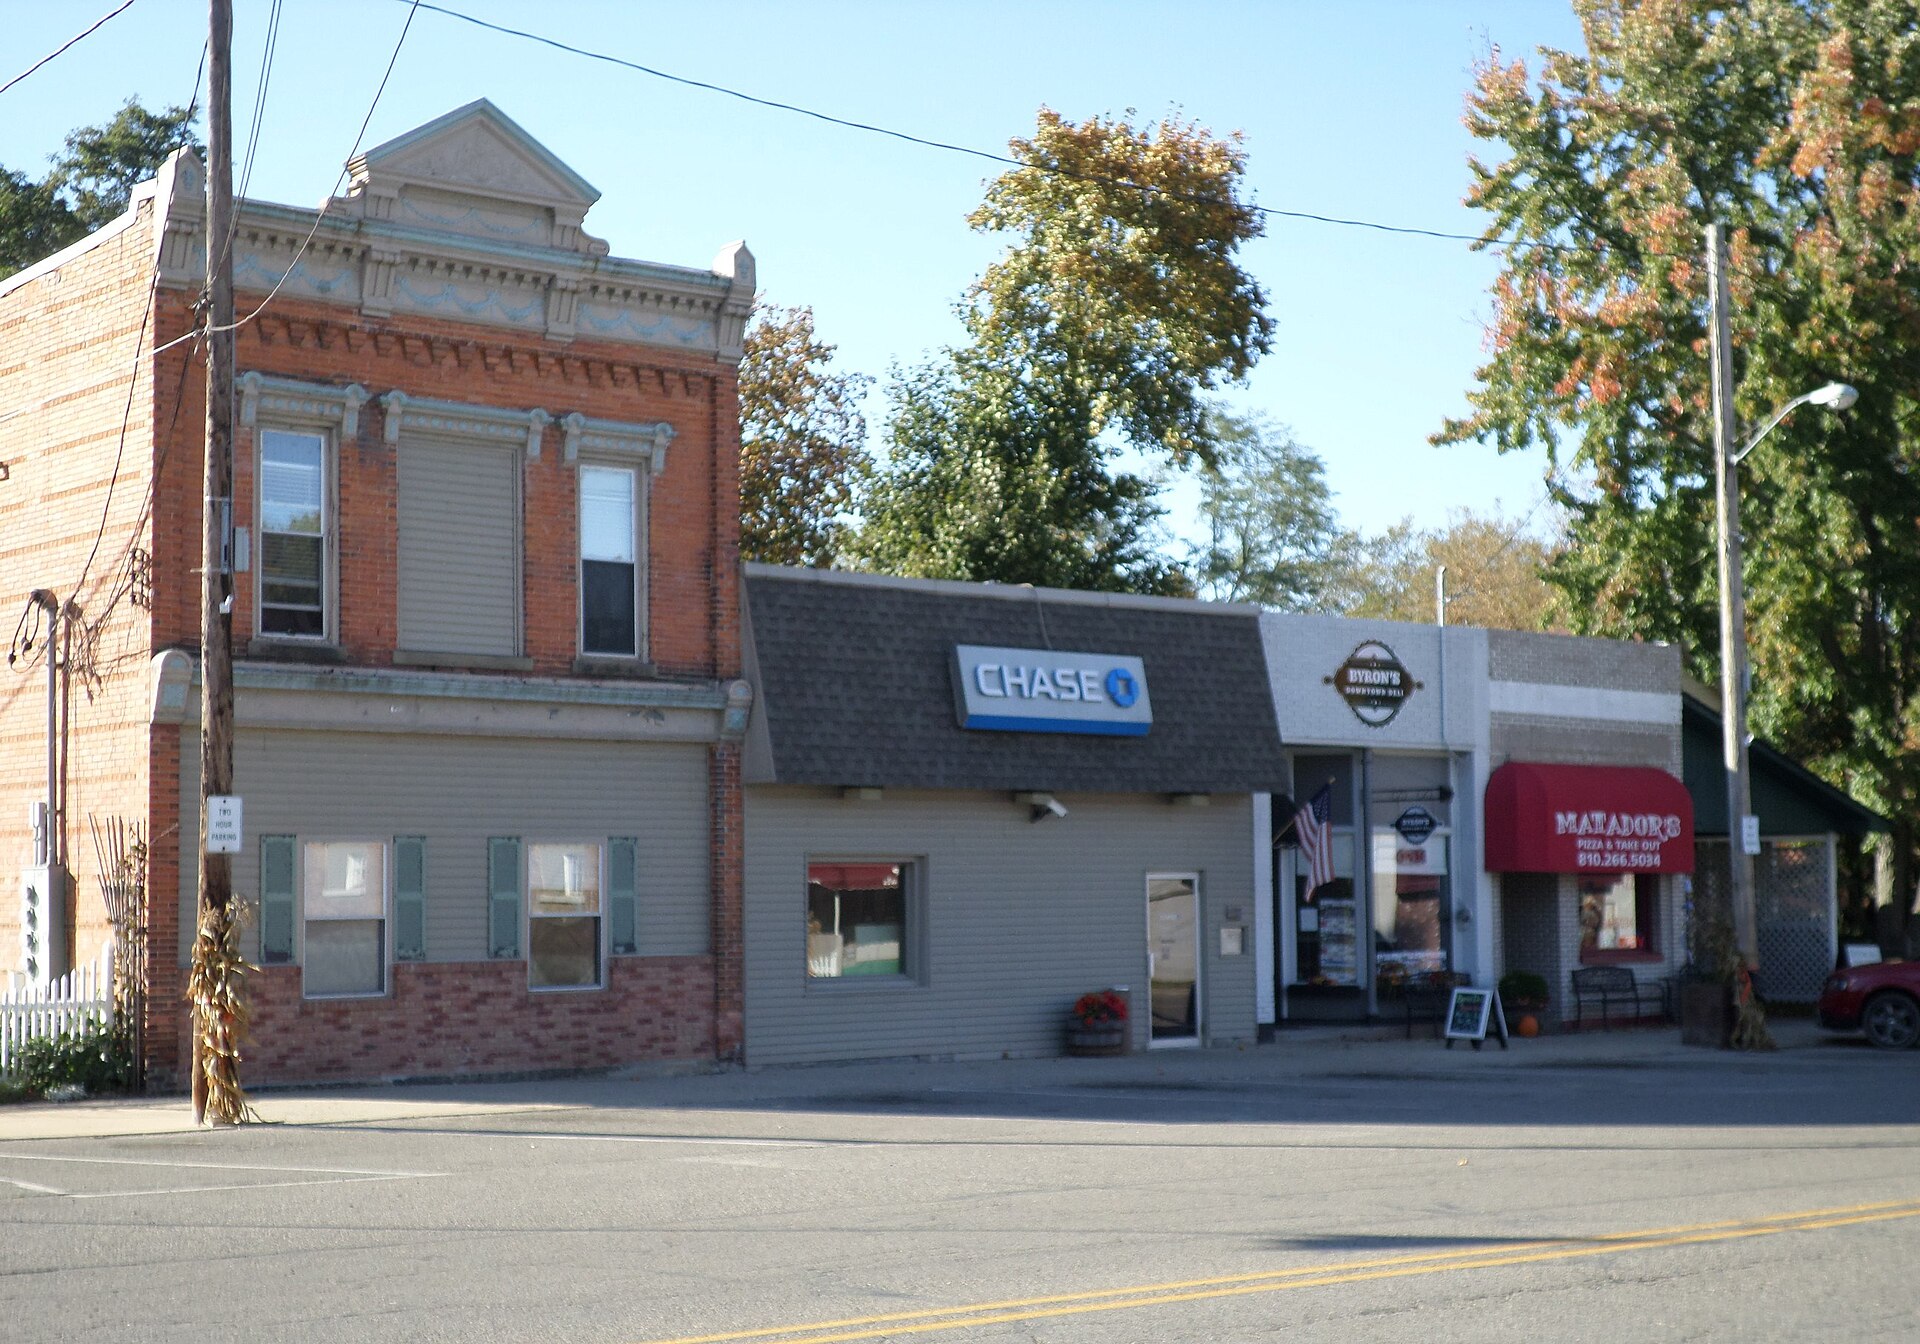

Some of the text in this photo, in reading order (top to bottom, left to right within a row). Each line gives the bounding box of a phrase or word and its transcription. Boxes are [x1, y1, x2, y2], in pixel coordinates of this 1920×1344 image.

[975, 663, 1103, 703] CHASE
[1348, 667, 1401, 686] BYRON'S
[1345, 686, 1404, 697] DOWNTOWN DELI
[218, 808, 232, 817] TWO
[215, 821, 232, 829] HOUR
[1555, 810, 1682, 842] MATADOR'S
[1578, 838, 1661, 851] PIZZA & TAKE OUT
[1577, 852, 1662, 868] 810.266.5034
